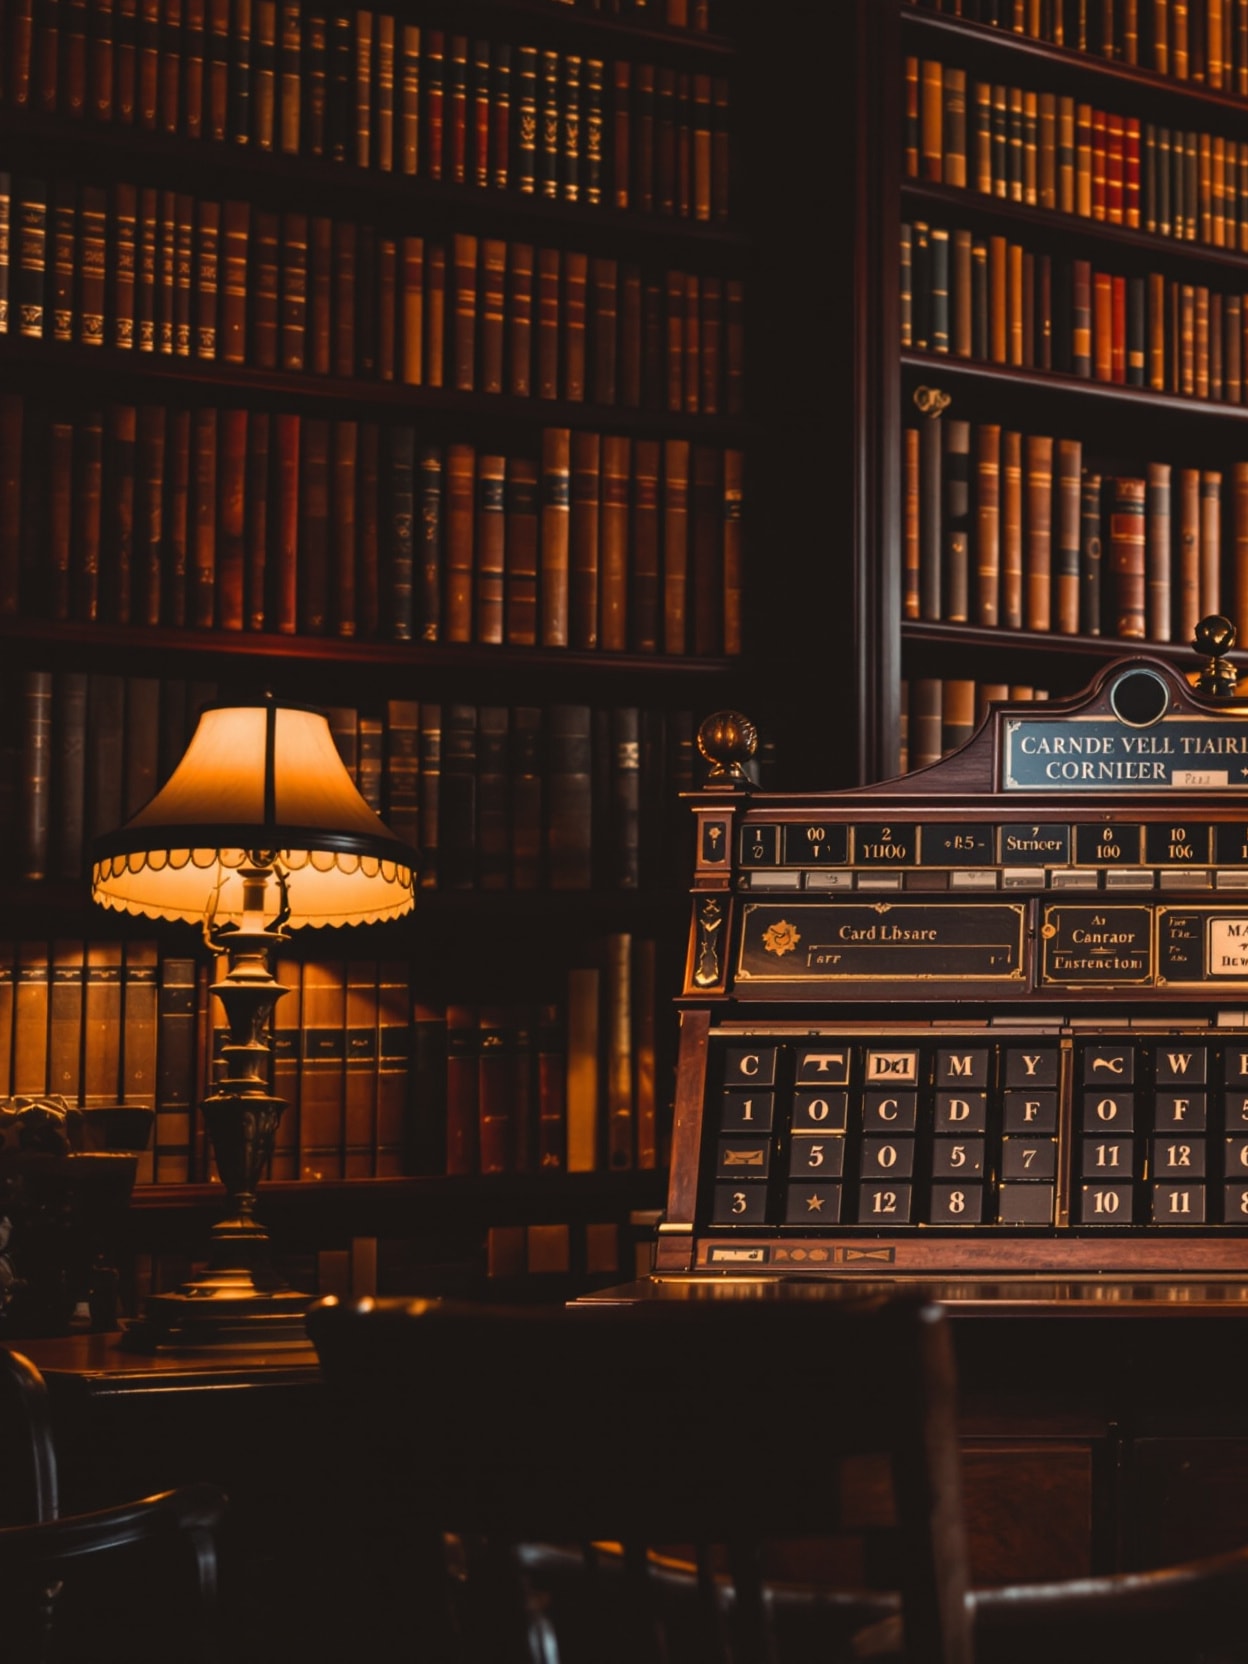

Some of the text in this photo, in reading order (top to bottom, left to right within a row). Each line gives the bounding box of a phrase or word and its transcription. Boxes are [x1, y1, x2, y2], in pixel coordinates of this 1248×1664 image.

[1122, 738, 1174, 753] VELL
[882, 828, 891, 840] 2
[1172, 829, 1185, 841] 10
[1098, 846, 1120, 858] 100
[839, 926, 875, 940] Card
[740, 1056, 758, 1075] C
[948, 1056, 972, 1075] M
[1023, 1056, 1040, 1074] Y
[1168, 1054, 1191, 1073] W
[743, 1100, 752, 1120] 1
[879, 1100, 897, 1120] C
[950, 1100, 969, 1120] D
[1024, 1102, 1040, 1120] F
[1174, 1100, 1189, 1120] F
[809, 1146, 823, 1166] 5
[951, 1147, 965, 1167] 5
[1023, 1150, 1036, 1168] 7
[1097, 1145, 1118, 1166] 11
[733, 1193, 746, 1213] 3
[873, 1192, 896, 1212] 12
[949, 1192, 964, 1213] 8
[1095, 1192, 1118, 1212] 10
[1170, 1192, 1189, 1212] 11
